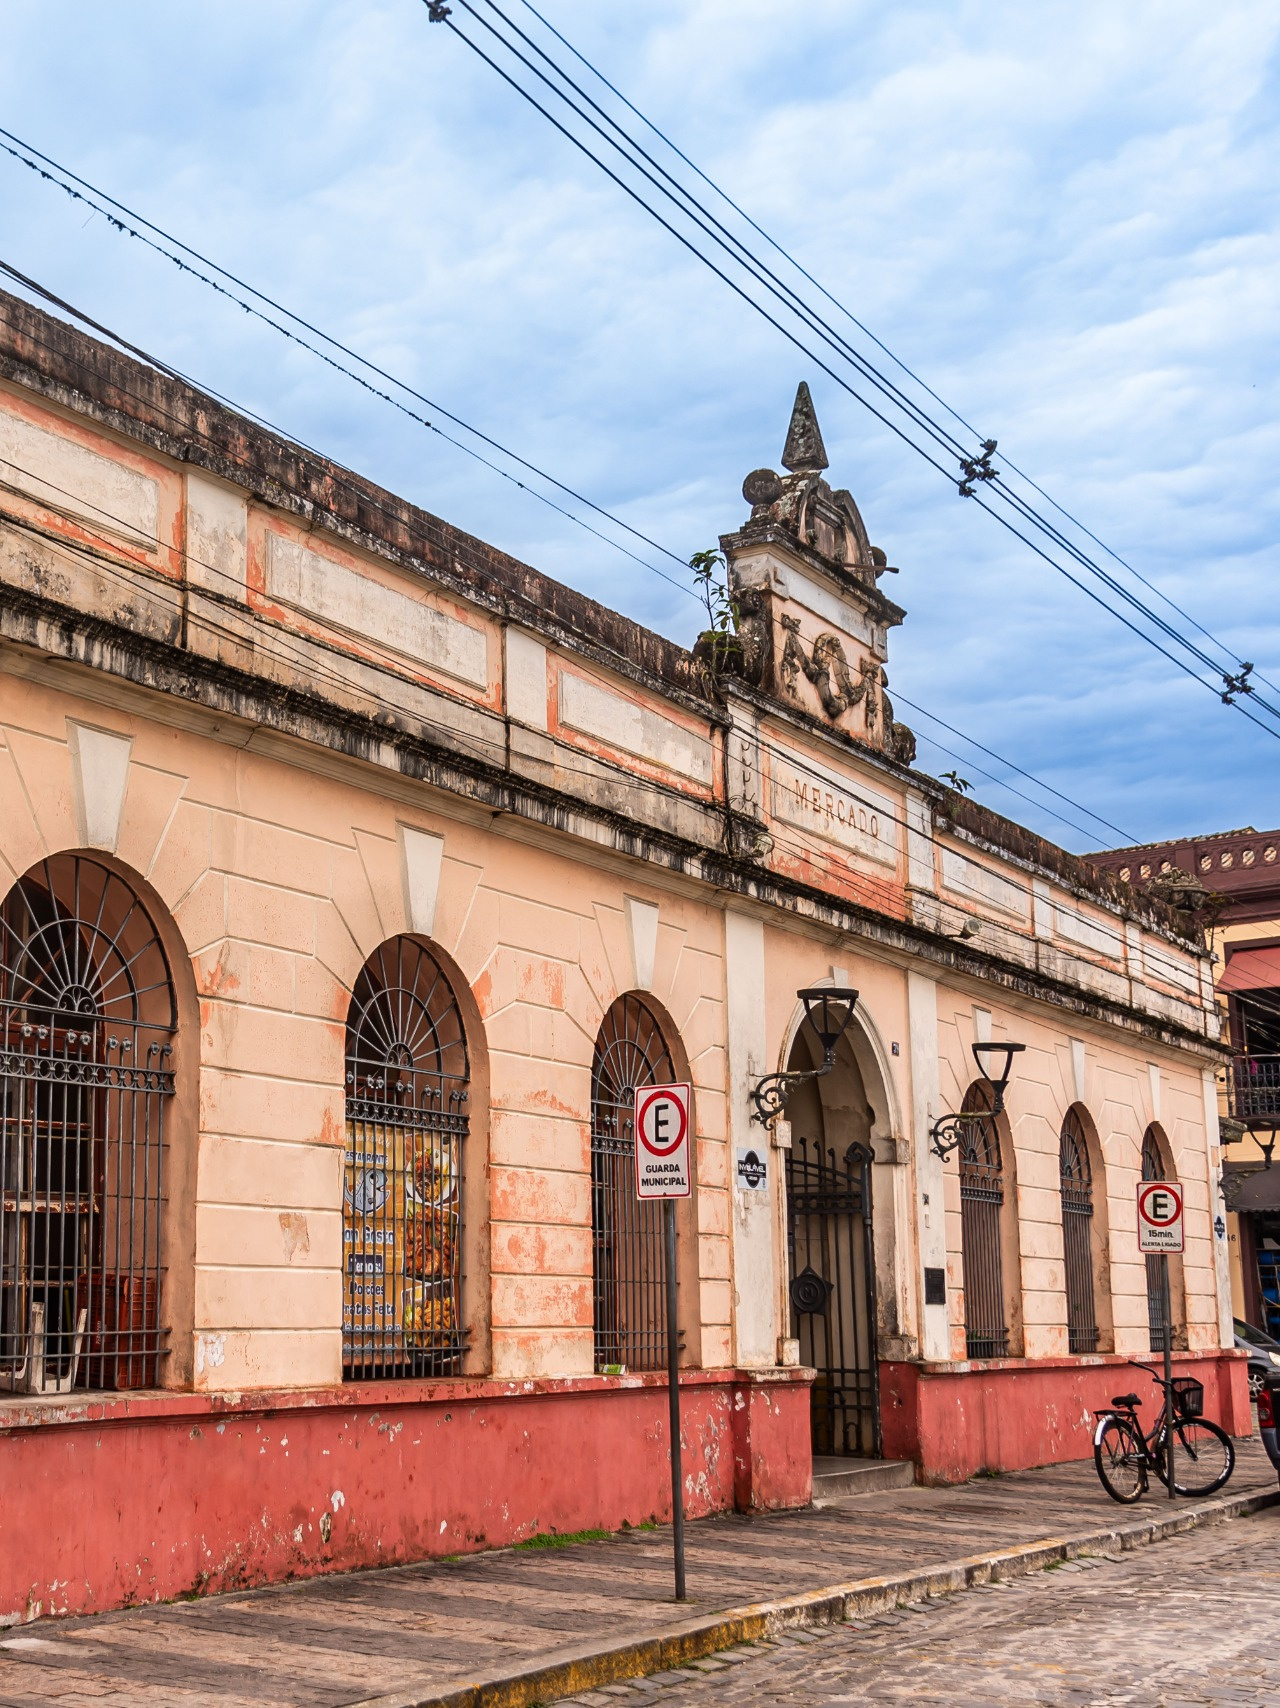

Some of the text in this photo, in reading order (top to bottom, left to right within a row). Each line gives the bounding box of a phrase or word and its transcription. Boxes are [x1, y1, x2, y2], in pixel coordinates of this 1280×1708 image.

[795, 779, 879, 837] MERCADO
[654, 1103, 669, 1143] E
[645, 1163, 681, 1174] GUARDA
[641, 1177, 687, 1187] MUNICIPAL
[1152, 1193, 1169, 1219] E
[349, 1280, 386, 1298] Poções
